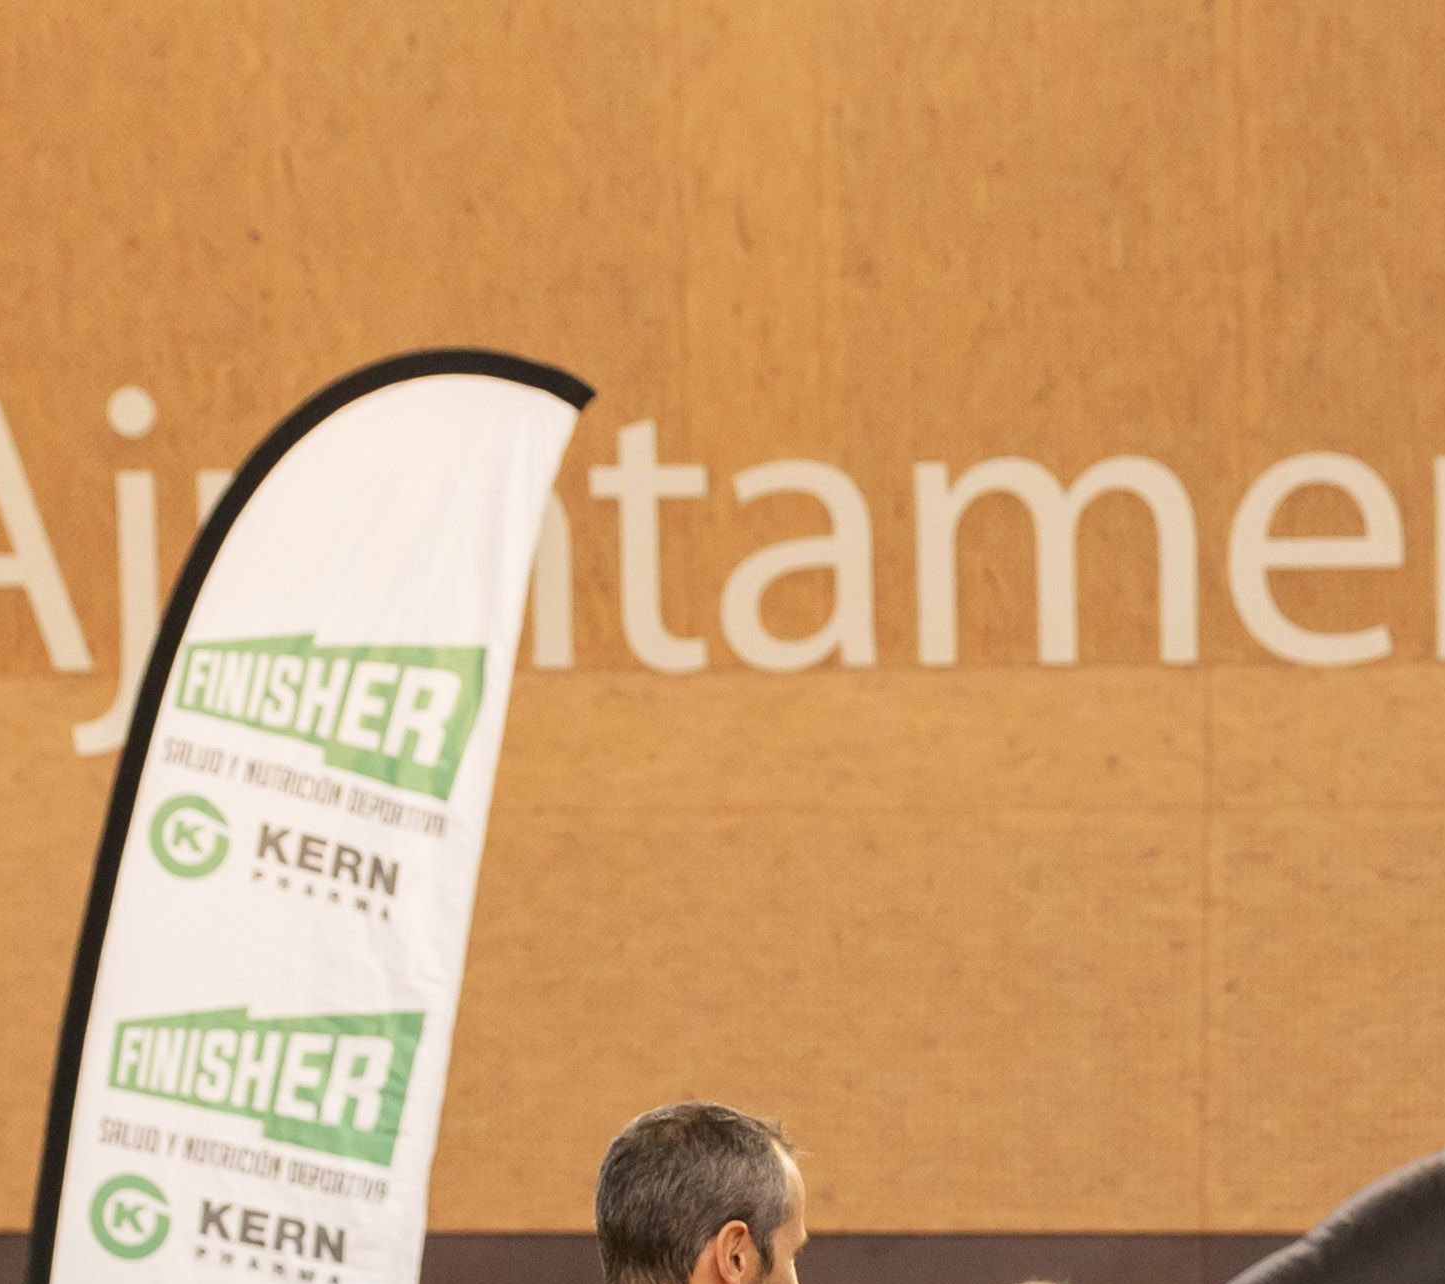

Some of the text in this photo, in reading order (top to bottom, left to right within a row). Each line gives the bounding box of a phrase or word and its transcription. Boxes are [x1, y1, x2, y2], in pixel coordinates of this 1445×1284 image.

[182, 648, 463, 768] FINISHER
[256, 823, 402, 897] KERN
[116, 1026, 395, 1133] FINISHER
[197, 1199, 347, 1265] KERN
